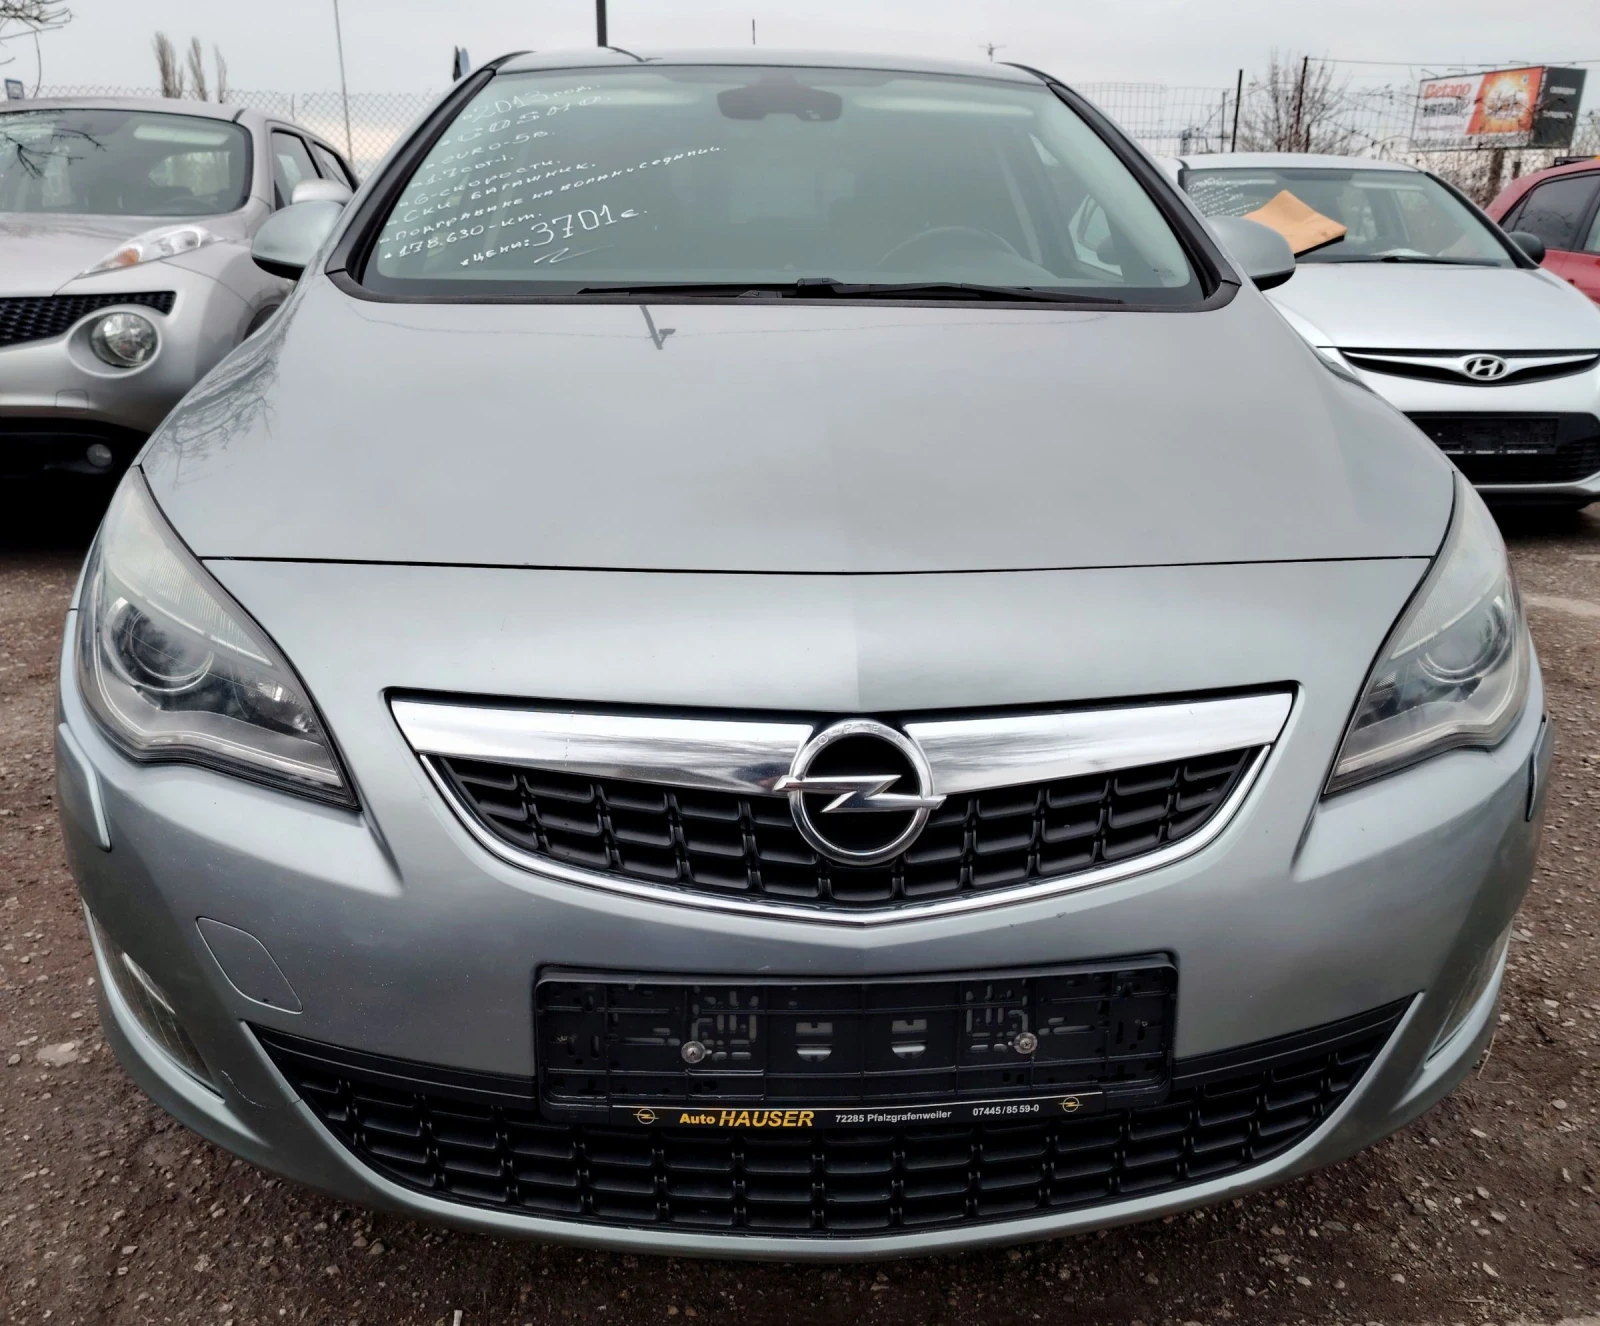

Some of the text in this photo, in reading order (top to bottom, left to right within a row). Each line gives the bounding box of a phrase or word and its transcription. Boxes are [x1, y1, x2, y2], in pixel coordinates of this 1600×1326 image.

[679, 1110, 815, 1127] Auto HAUSER
[835, 1110, 953, 1124] 72285 Pfalzgrafenweiler
